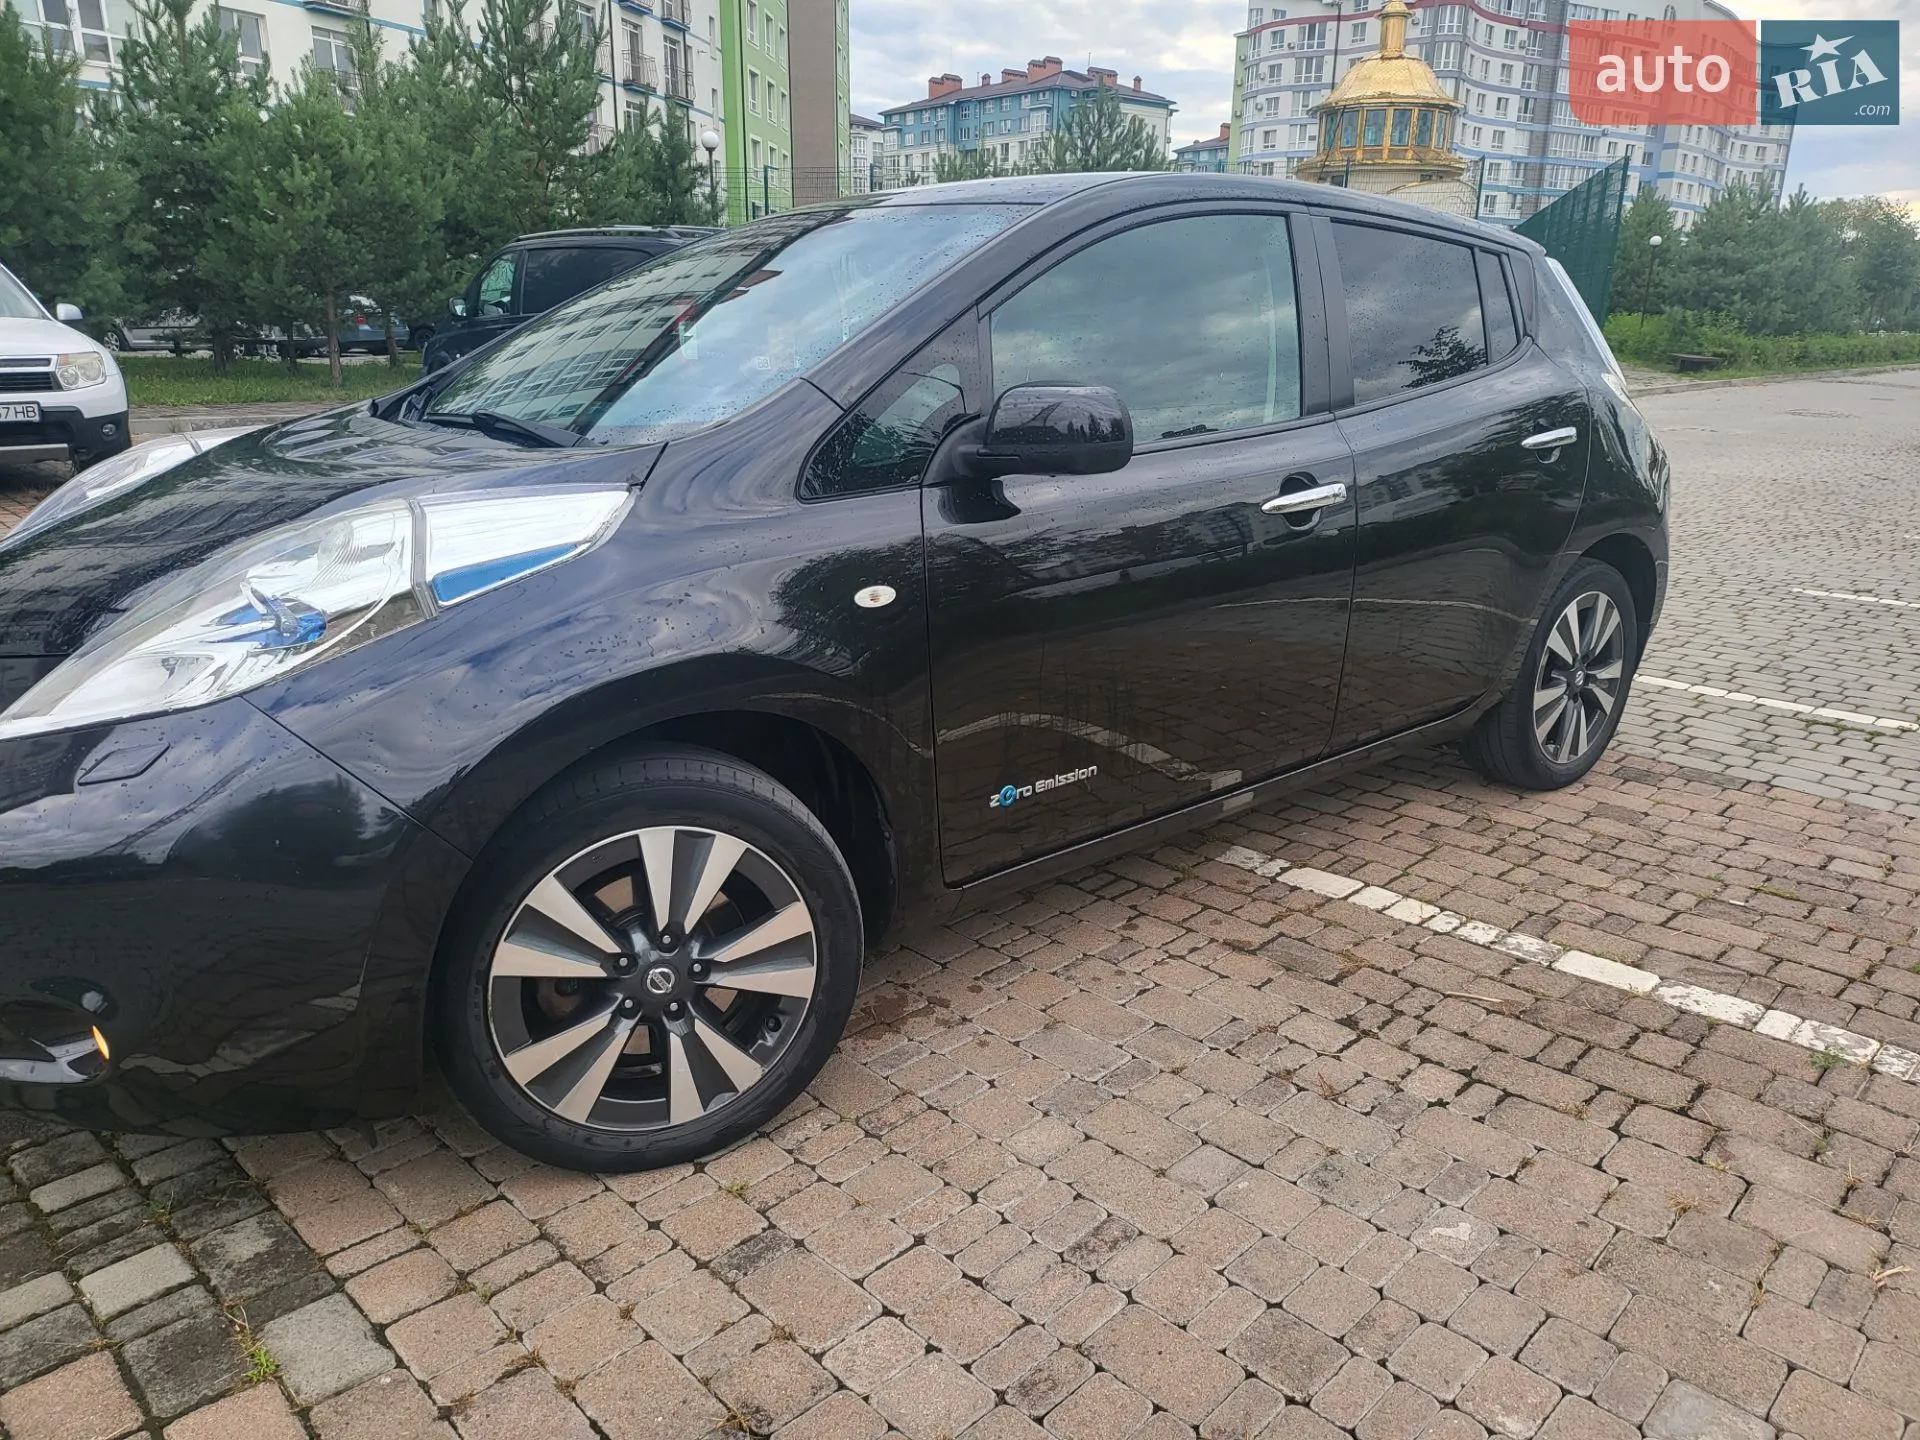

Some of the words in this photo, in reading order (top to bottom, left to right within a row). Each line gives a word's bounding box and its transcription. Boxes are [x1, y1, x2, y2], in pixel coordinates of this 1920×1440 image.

[0, 406, 10, 419] 7
[14, 405, 36, 418] HB
[1035, 765, 1098, 792] Emission
